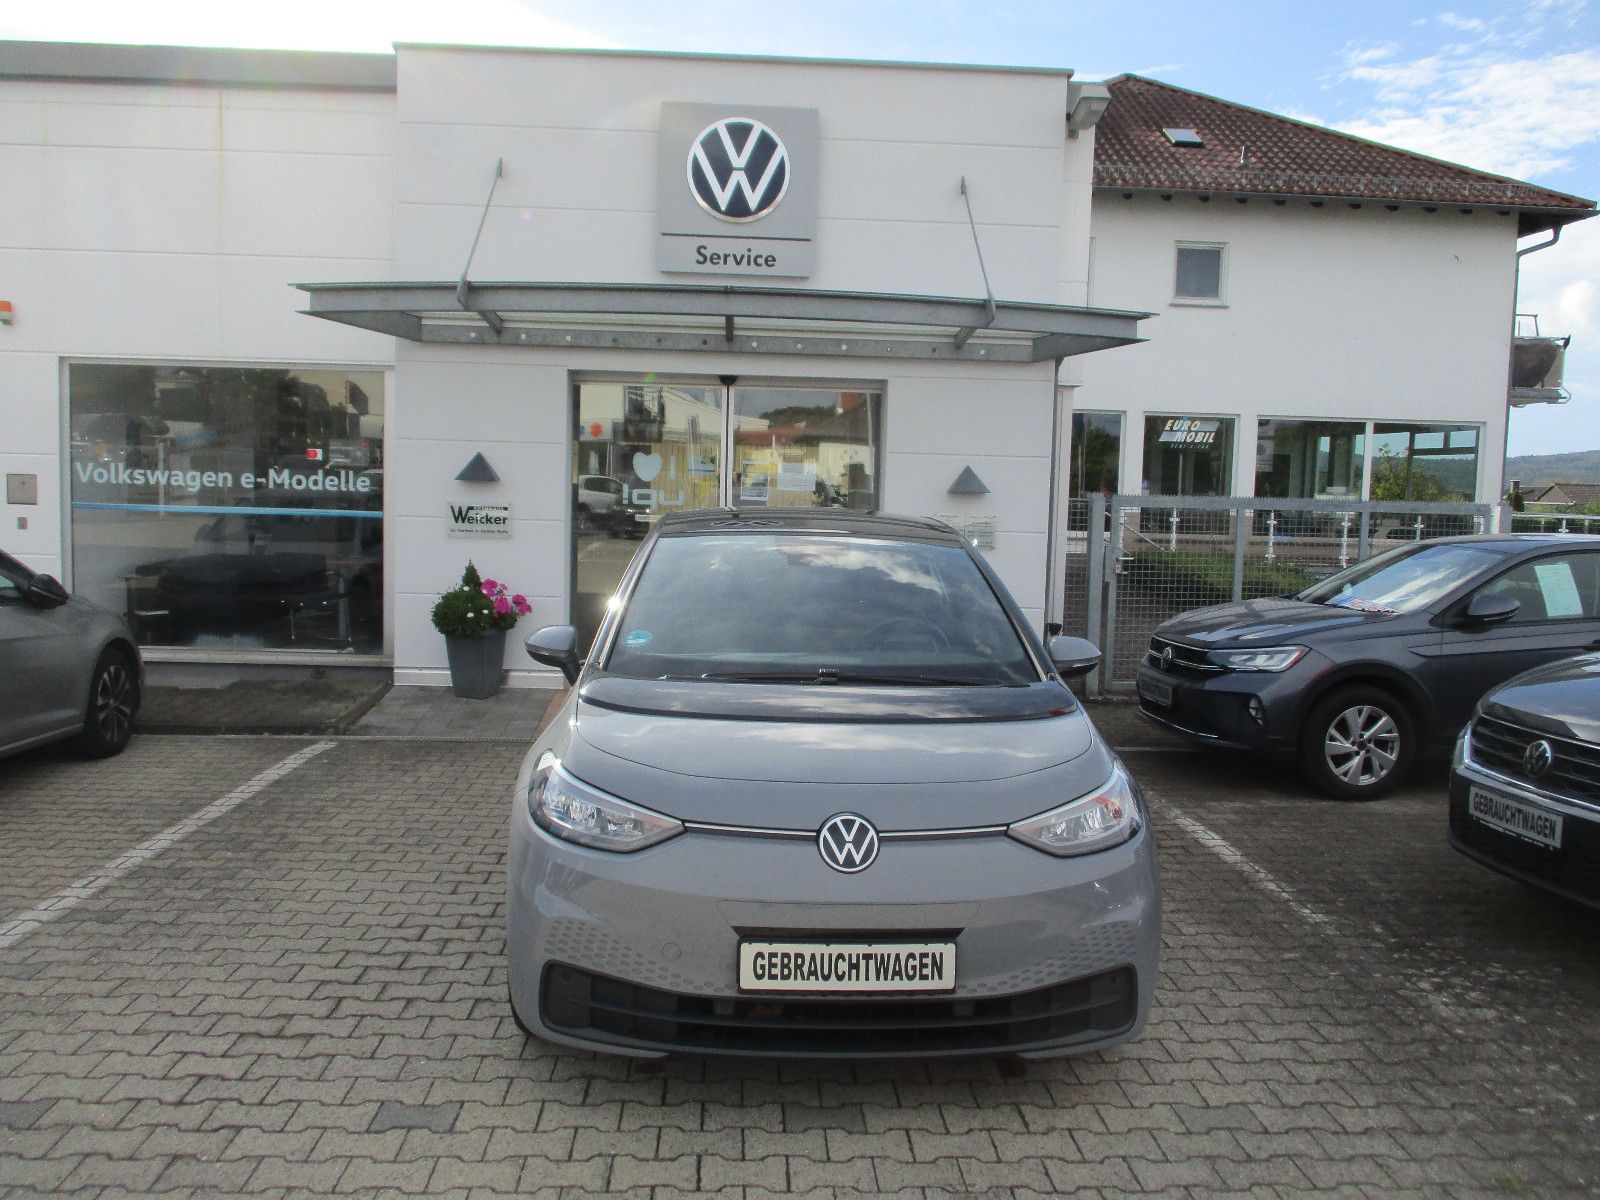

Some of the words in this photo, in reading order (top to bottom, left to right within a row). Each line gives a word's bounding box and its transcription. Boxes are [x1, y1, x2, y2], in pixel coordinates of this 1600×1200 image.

[689, 119, 788, 217] VW
[696, 245, 776, 267] Service
[1164, 419, 1200, 431] EURO
[1176, 432, 1215, 443] MOBIL
[76, 461, 233, 492] Volkswagen
[240, 468, 371, 493] e-Modelle
[450, 506, 508, 525] Weicker
[1473, 792, 1557, 841] GEBRAUCHTWAGEN
[820, 815, 878, 873] VW
[752, 951, 944, 982] GEBRAUCHTWAGEN
